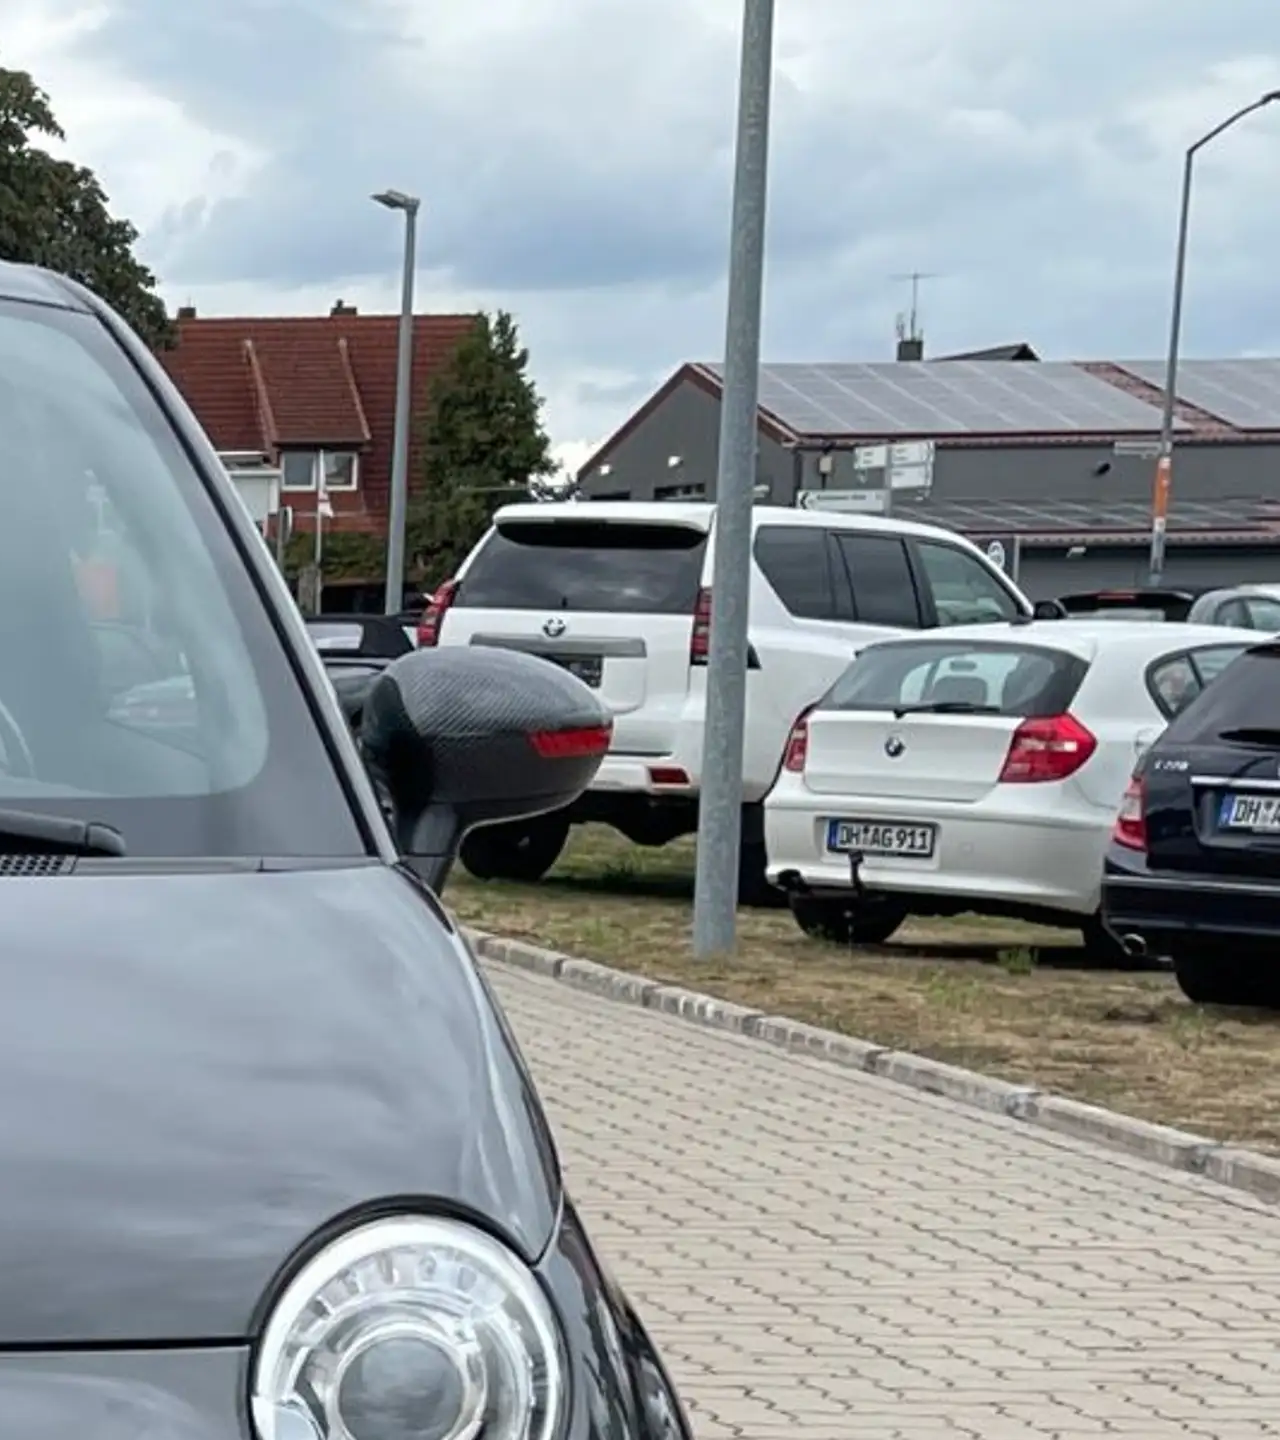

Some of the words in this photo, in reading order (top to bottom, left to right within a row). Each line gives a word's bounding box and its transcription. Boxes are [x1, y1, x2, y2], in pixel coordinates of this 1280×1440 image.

[1232, 799, 1262, 824] DH
[839, 826, 861, 846] DH
[871, 827, 893, 848] AG
[895, 829, 928, 850] 911
